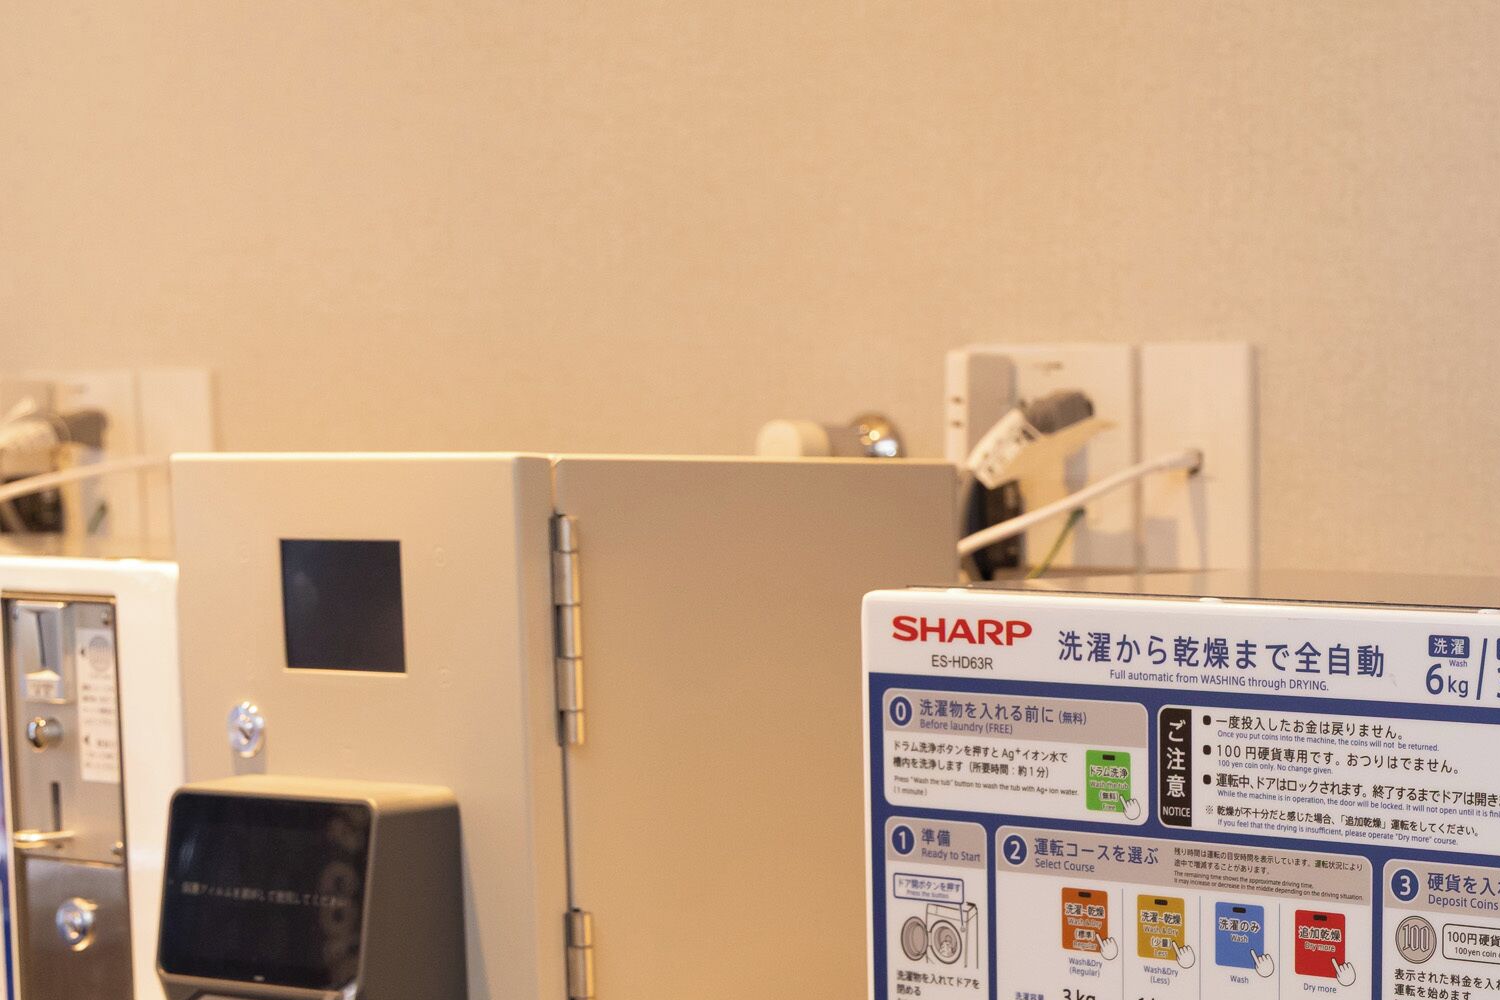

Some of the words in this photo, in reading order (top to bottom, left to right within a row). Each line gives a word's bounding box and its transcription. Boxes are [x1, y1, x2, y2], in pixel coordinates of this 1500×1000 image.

[892, 615, 1032, 646] SHARP
[1058, 630, 1384, 678] 洗濯から乾燥まで全自動
[1434, 637, 1465, 655] 洗濯
[931, 655, 993, 670] ES-HD63R
[1449, 659, 1467, 667] Wash
[1110, 670, 1126, 680] Full
[1127, 671, 1174, 682] automatic
[1175, 673, 1198, 683] from
[1200, 674, 1246, 686] WASHING
[1247, 676, 1287, 690] through
[1288, 678, 1328, 690] DRYING.
[920, 699, 1054, 723] 洗濯物を入れる前に
[919, 719, 948, 730] Before
[949, 721, 983, 734] laundry
[984, 723, 1013, 736] (FREE)
[1216, 715, 1402, 740] 一度投入したお金は戻りません。
[1166, 719, 1186, 798] ご注意
[1089, 766, 1128, 778] ドラム洗浄
[1231, 762, 1243, 770] yen
[1259, 763, 1275, 772] only.
[1287, 765, 1312, 774] change
[1163, 806, 1190, 818] NOTICE
[899, 831, 907, 850] 1
[922, 828, 951, 847] 準備
[921, 848, 948, 861] Ready
[949, 851, 959, 860] to
[960, 852, 981, 862] Start
[1009, 840, 1021, 860] 2
[1034, 839, 1159, 865] 運転コースを選ぶ
[1035, 858, 1061, 870] Select
[1063, 860, 1095, 872] Course
[1400, 875, 1411, 896] 3
[1428, 894, 1468, 909] Deposit
[1469, 898, 1499, 910] Coins
[1219, 917, 1260, 933] 洗濯のみ
[1299, 926, 1341, 942] 追加乾燥
[1151, 976, 1170, 985] (Less)
[1230, 975, 1249, 984] Wash
[1303, 983, 1315, 992] Dry
